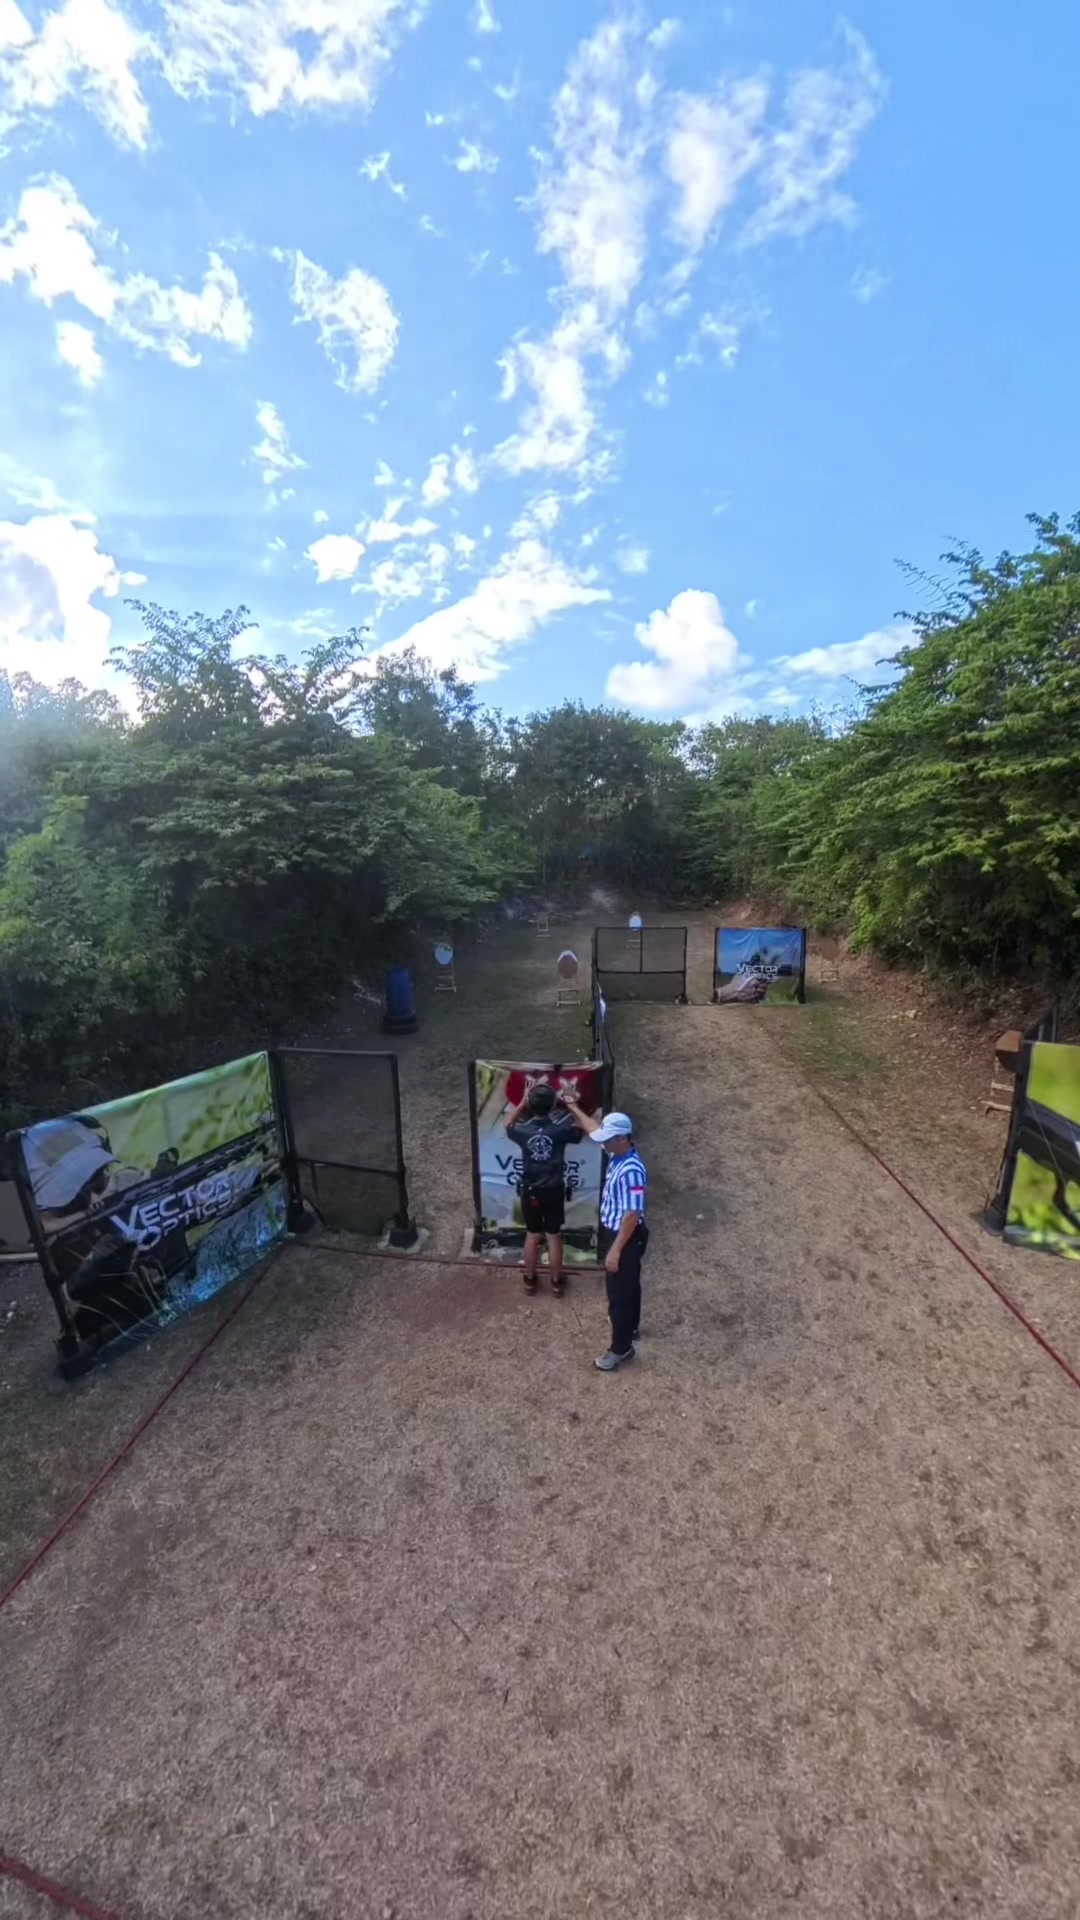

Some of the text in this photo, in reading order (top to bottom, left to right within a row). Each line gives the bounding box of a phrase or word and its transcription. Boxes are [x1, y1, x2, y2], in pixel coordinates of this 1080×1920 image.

[736, 963, 778, 974] VECTOR
[495, 1154, 580, 1173] VER
[110, 1180, 232, 1239] VECTOR
[137, 1198, 235, 1251] OPTICS
